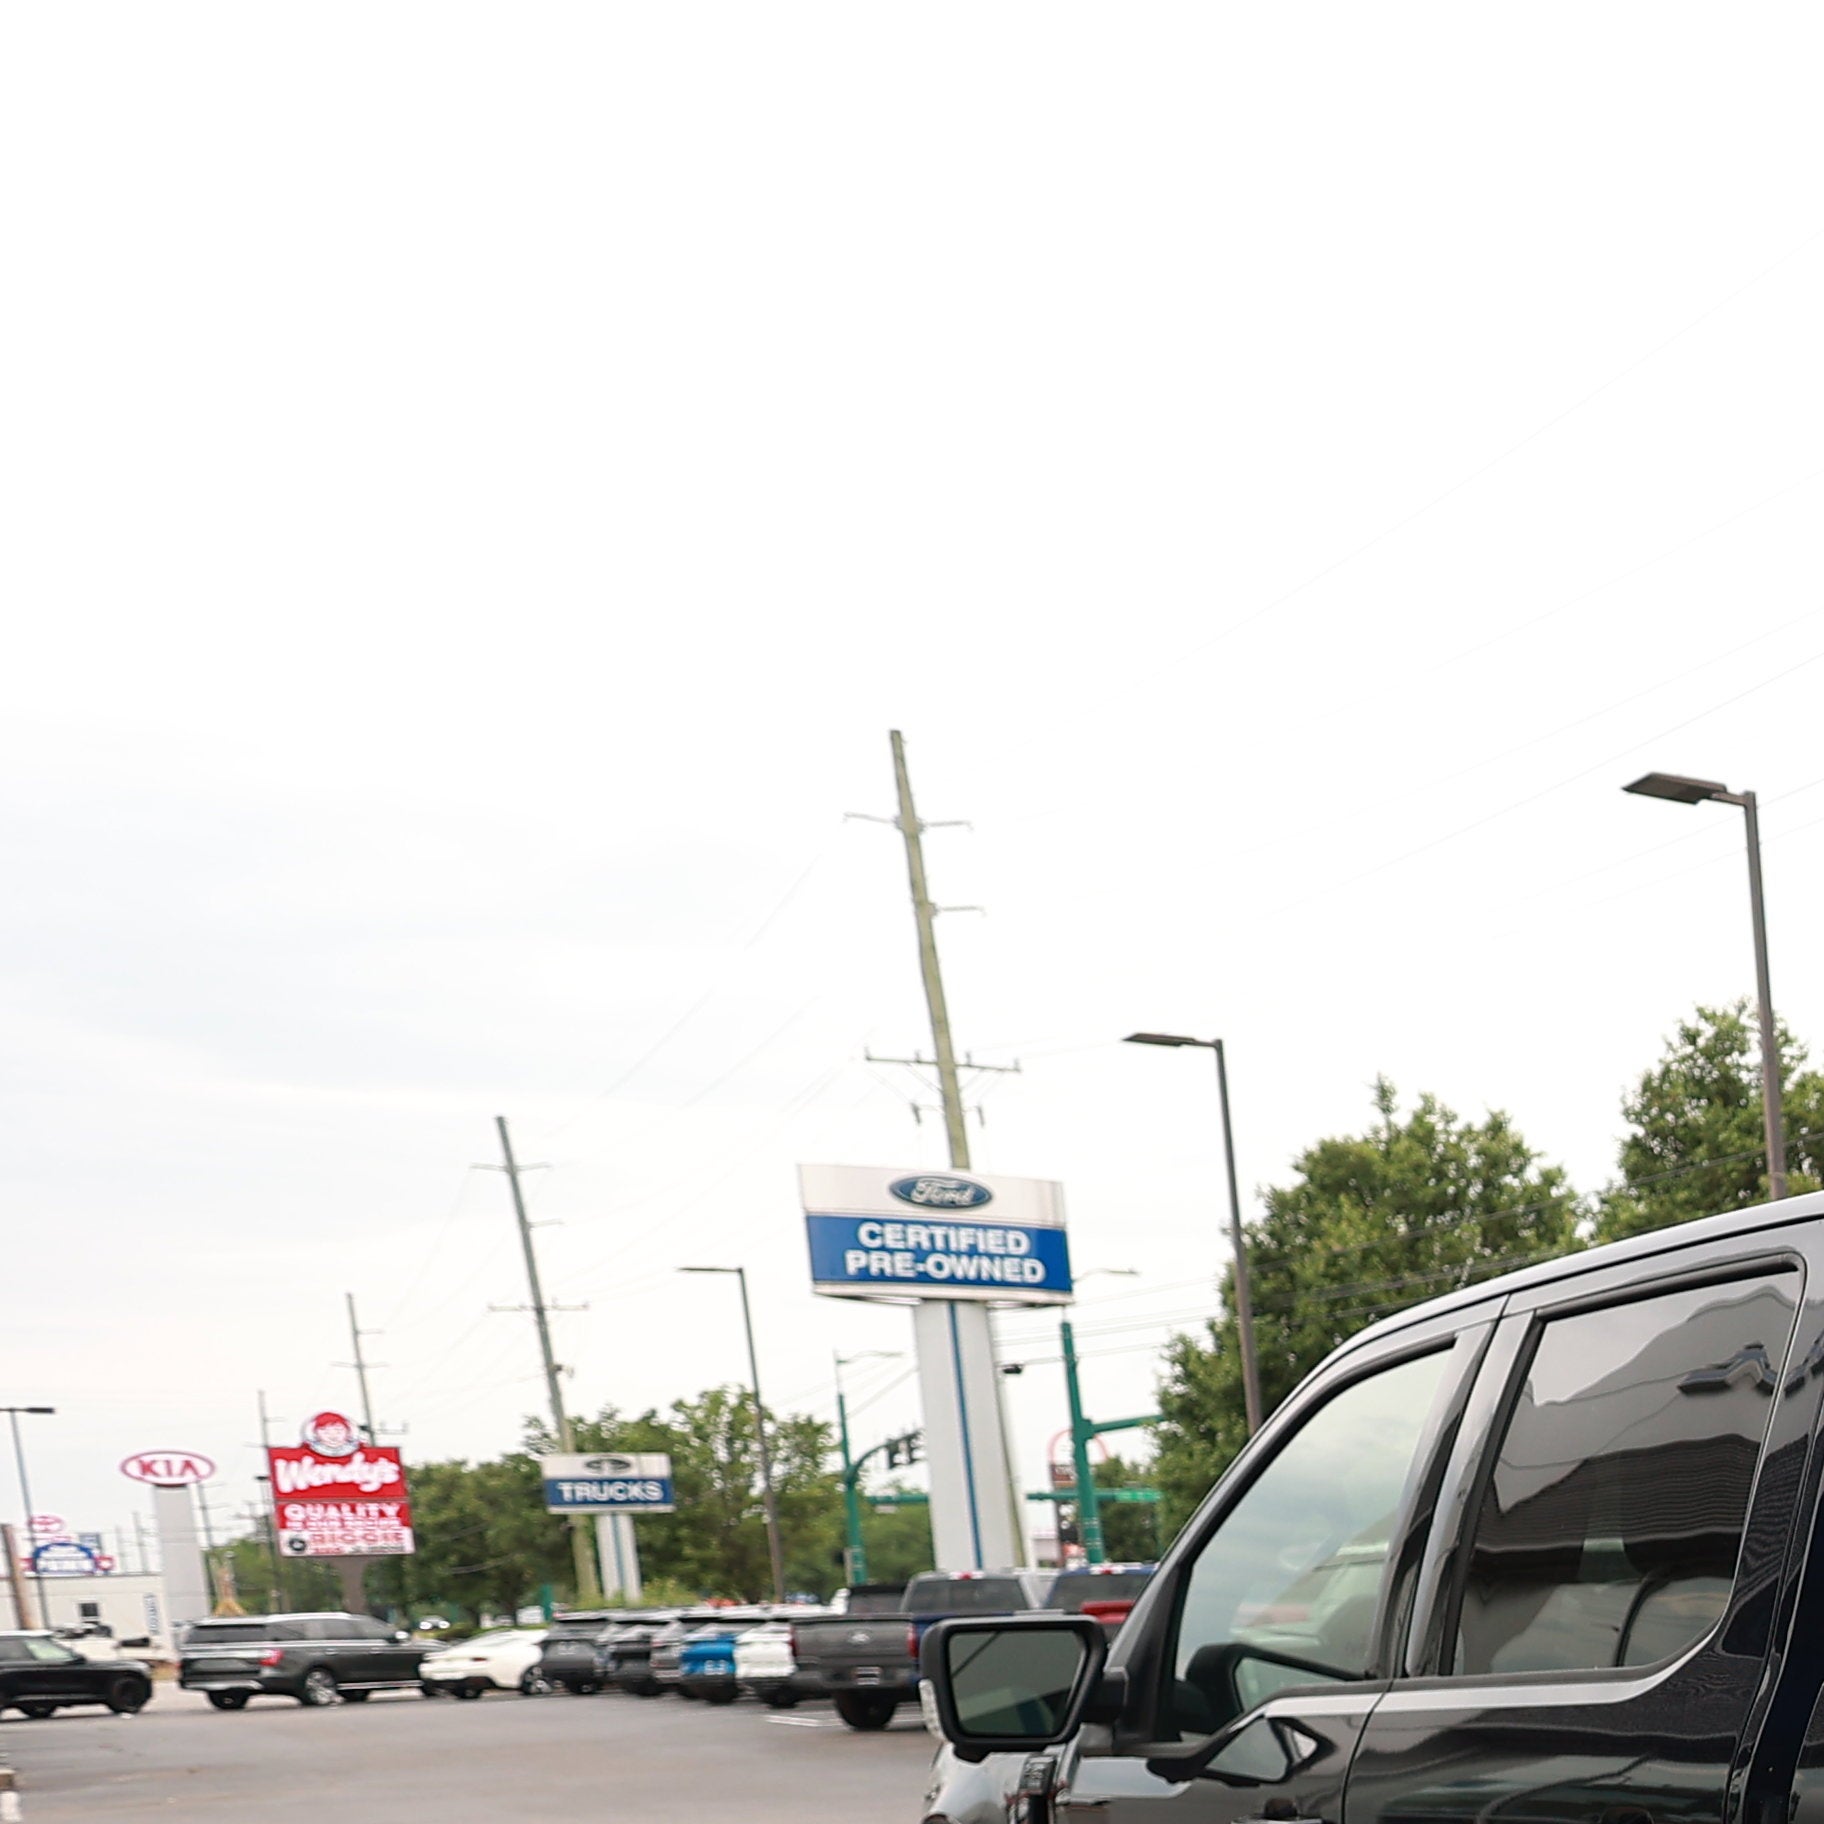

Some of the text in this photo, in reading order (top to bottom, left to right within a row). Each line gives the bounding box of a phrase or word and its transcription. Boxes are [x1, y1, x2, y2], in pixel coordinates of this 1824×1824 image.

[911, 1178, 975, 1206] Ford
[857, 1221, 1030, 1255] CERTIFIED
[845, 1250, 1046, 1283] PRE-OWNED
[138, 1459, 200, 1478] KIA
[274, 1451, 400, 1493] Wendy's
[557, 1481, 664, 1502] TRUCKS
[284, 1503, 400, 1520] QUALITY
